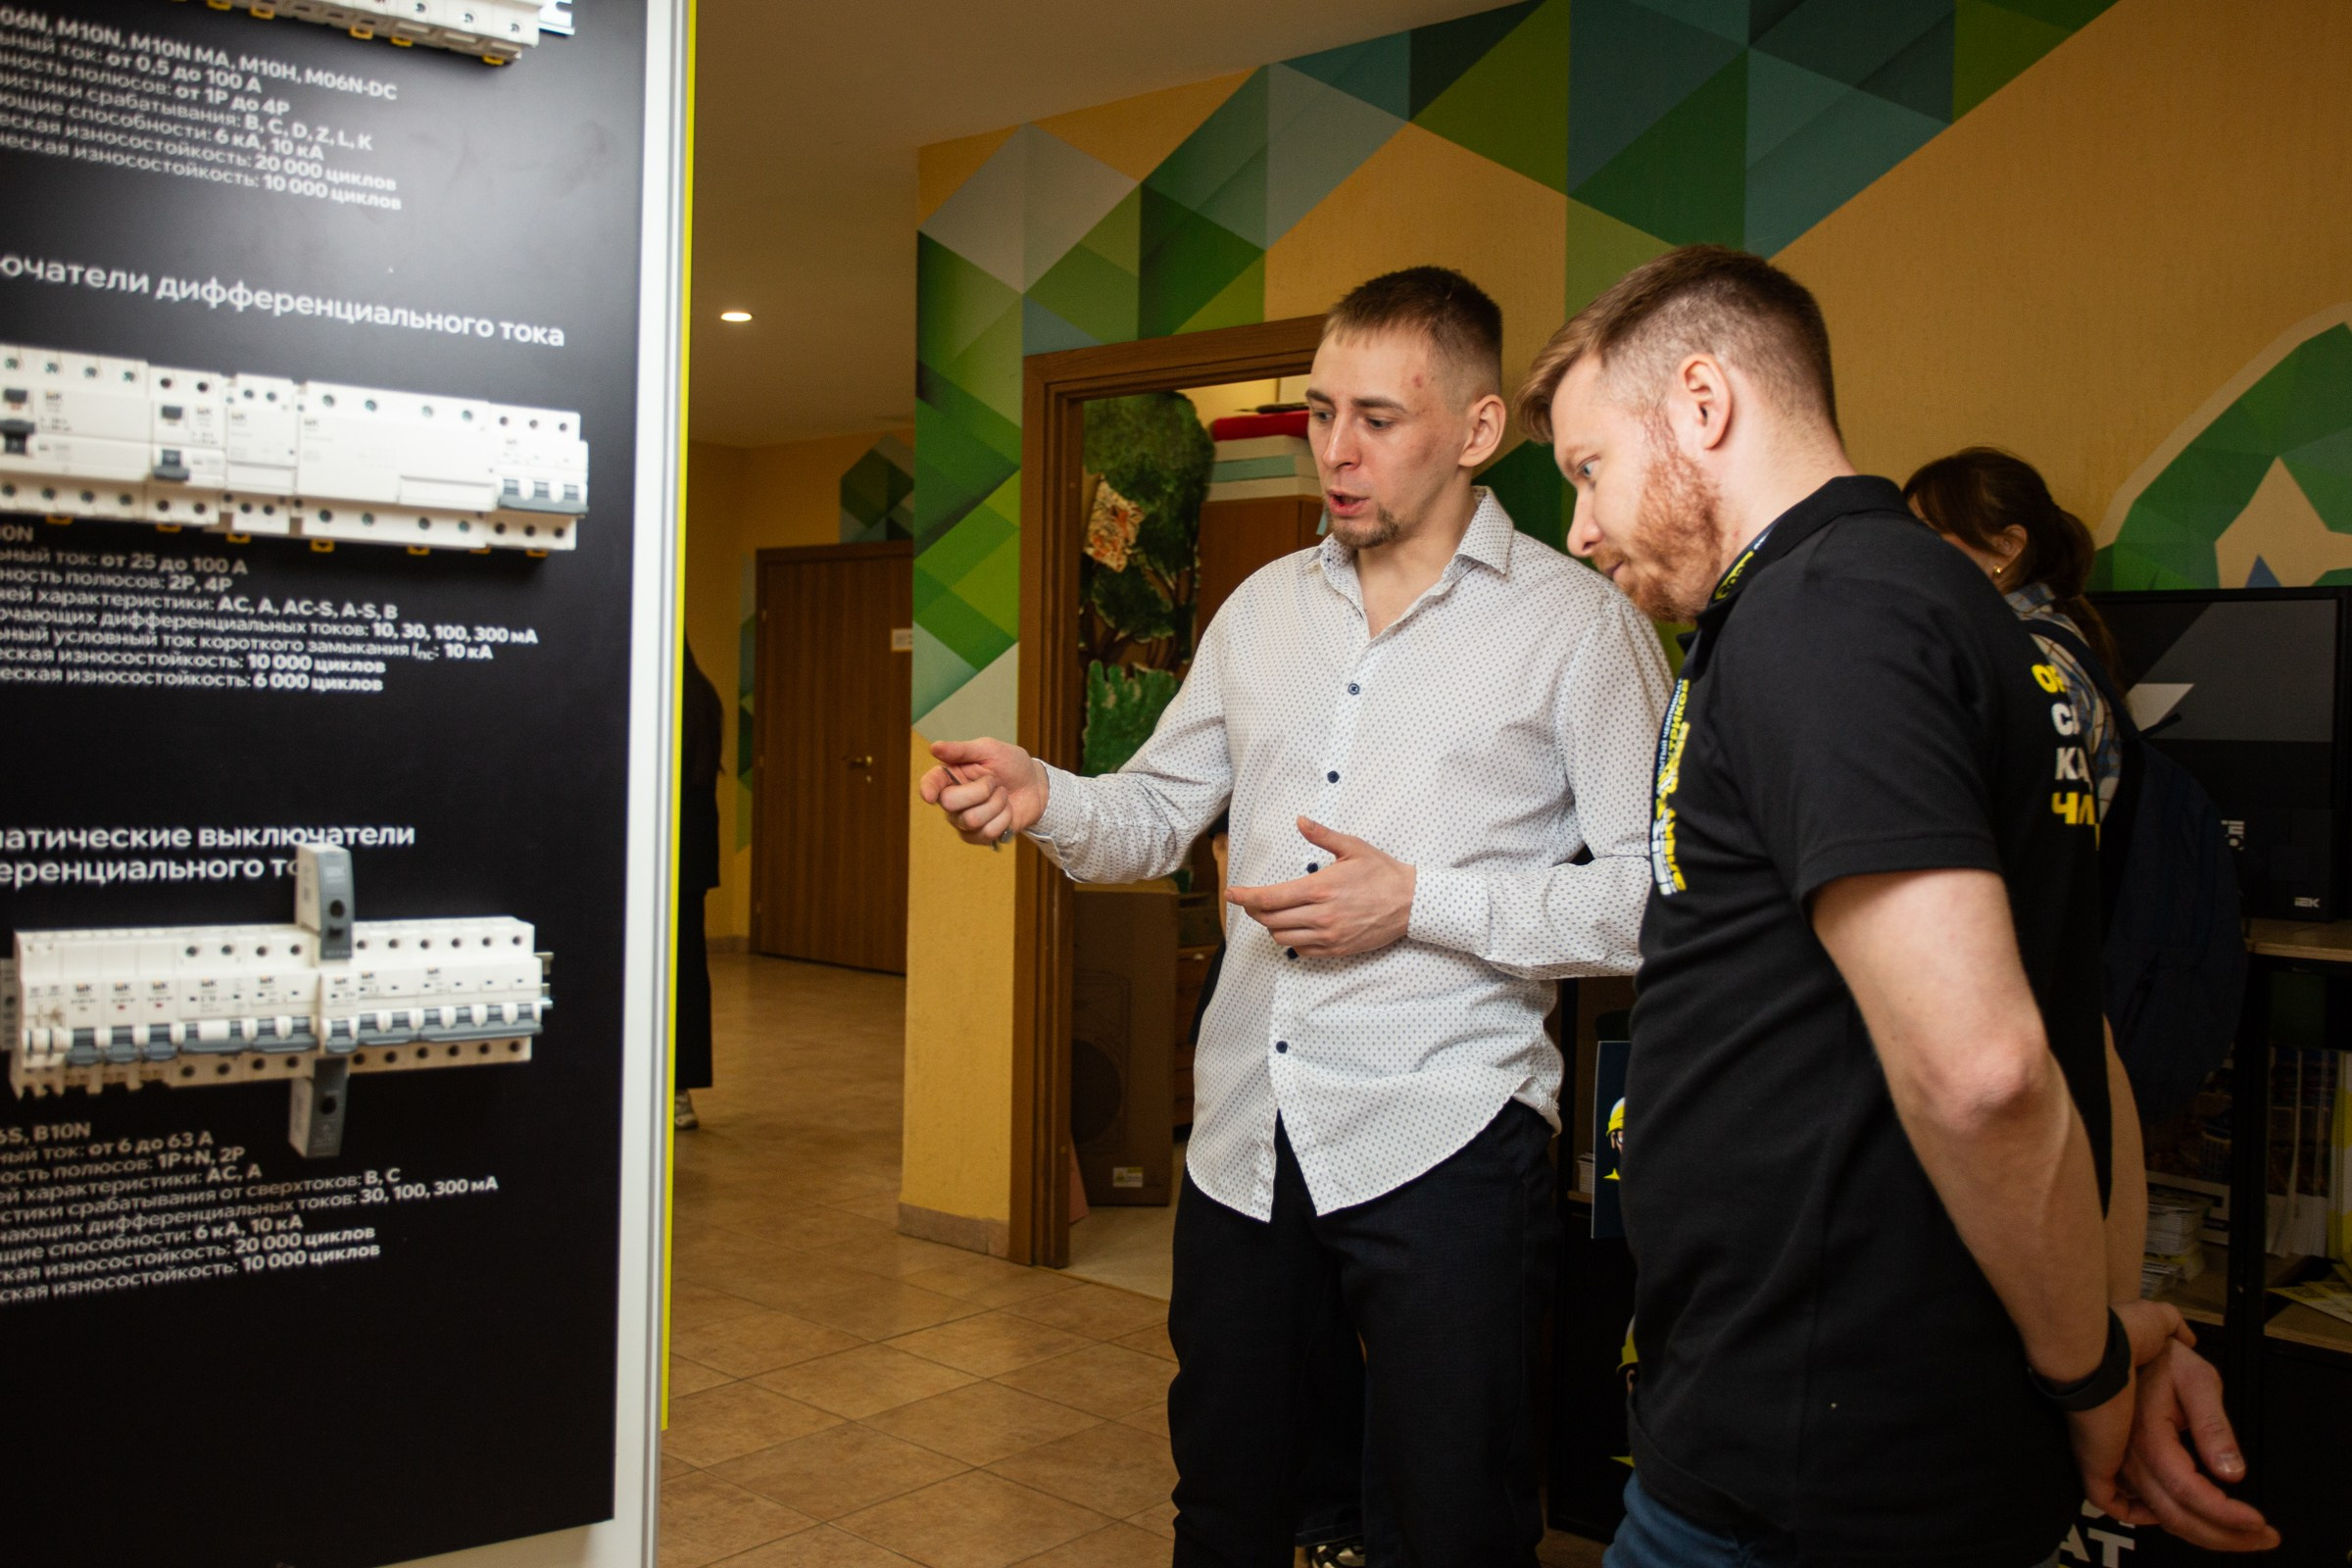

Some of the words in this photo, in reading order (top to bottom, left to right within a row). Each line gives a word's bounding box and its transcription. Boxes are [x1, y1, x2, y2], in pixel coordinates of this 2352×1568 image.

[57, 17, 126, 50] M10N,
[130, 32, 191, 61] M10N
[196, 45, 235, 72] MA,
[239, 55, 302, 85] M10H,
[305, 68, 398, 101] M06N-DC
[60, 44, 103, 63] ток:
[106, 52, 132, 69] от
[135, 55, 170, 76] 0,5
[172, 66, 202, 83] до
[206, 69, 242, 90] 100
[0, 55, 68, 76] ность
[72, 66, 172, 96] полюсов:
[174, 85, 201, 101] от
[230, 95, 259, 114] до
[69, 103, 211, 142] способности:
[214, 128, 229, 144] 6
[270, 138, 293, 155] 10
[86, 87, 241, 128] срабатывания:
[292, 122, 313, 142] D,
[317, 126, 334, 146] Z,
[338, 130, 355, 150] L,
[65, 124, 252, 168] износостойкость:
[256, 153, 280, 172] 20
[283, 158, 322, 178] 000
[325, 168, 397, 191] циклов
[73, 146, 259, 188] износостойкость:
[264, 173, 285, 191] 10
[289, 178, 327, 198] 000
[330, 187, 402, 211] циклов
[155, 275, 495, 338] дифференциального
[499, 319, 564, 347] тока
[56, 552, 97, 566] ток:
[100, 554, 126, 568] от
[129, 553, 157, 570] 25
[159, 558, 188, 574] до
[194, 557, 229, 574] 100
[65, 569, 166, 590] полюсов:
[36, 588, 215, 612] характеристики:
[53, 629, 158, 647] условный
[162, 635, 196, 649] ток
[199, 636, 305, 654] короткого
[308, 640, 410, 658] замыкания
[444, 643, 466, 660] 10
[100, 610, 307, 637] дифференциальных
[310, 621, 369, 638] токов:
[371, 621, 399, 640] 10,
[402, 623, 431, 641] 30,
[434, 624, 471, 643] 100,
[473, 625, 509, 643] 300
[58, 649, 244, 669] износостойкость:
[248, 654, 270, 669] 10
[272, 654, 313, 671] 000
[314, 659, 386, 674] циклов
[66, 667, 251, 688] износостойкость:
[253, 674, 268, 689] 6
[270, 673, 309, 690] 000
[311, 676, 384, 692] циклов
[1667, 679, 1690, 753] ТРИКОВ
[198, 825, 416, 849] выключатели
[33, 1122, 91, 1143] B10N
[42, 1146, 85, 1160] ток:
[88, 1143, 114, 1156] от
[117, 1138, 132, 1153] 6
[136, 1139, 164, 1154] до
[167, 1132, 194, 1150] 63
[25, 1173, 202, 1203] характеристики:
[53, 1159, 153, 1179] полюсов:
[68, 1188, 217, 1218] срабатывания
[219, 1187, 243, 1200] от
[246, 1175, 362, 1199] сверхтоков:
[87, 1199, 294, 1236] дифференциальных
[297, 1194, 357, 1211] токов:
[359, 1187, 390, 1204] 30,
[393, 1183, 430, 1201] 100,
[433, 1178, 468, 1197] 300
[0, 1265, 41, 1283] кая
[44, 1245, 231, 1277] износостойкость:
[234, 1238, 260, 1255] 20
[262, 1233, 302, 1252] 000
[305, 1227, 375, 1248] циклов
[48, 1230, 191, 1258] способности:
[194, 1224, 209, 1240] 6
[250, 1217, 271, 1235] 10
[52, 1262, 238, 1296] износостойкость:
[242, 1253, 264, 1272] 10
[268, 1250, 307, 1269] 000
[310, 1245, 381, 1266] циклов
